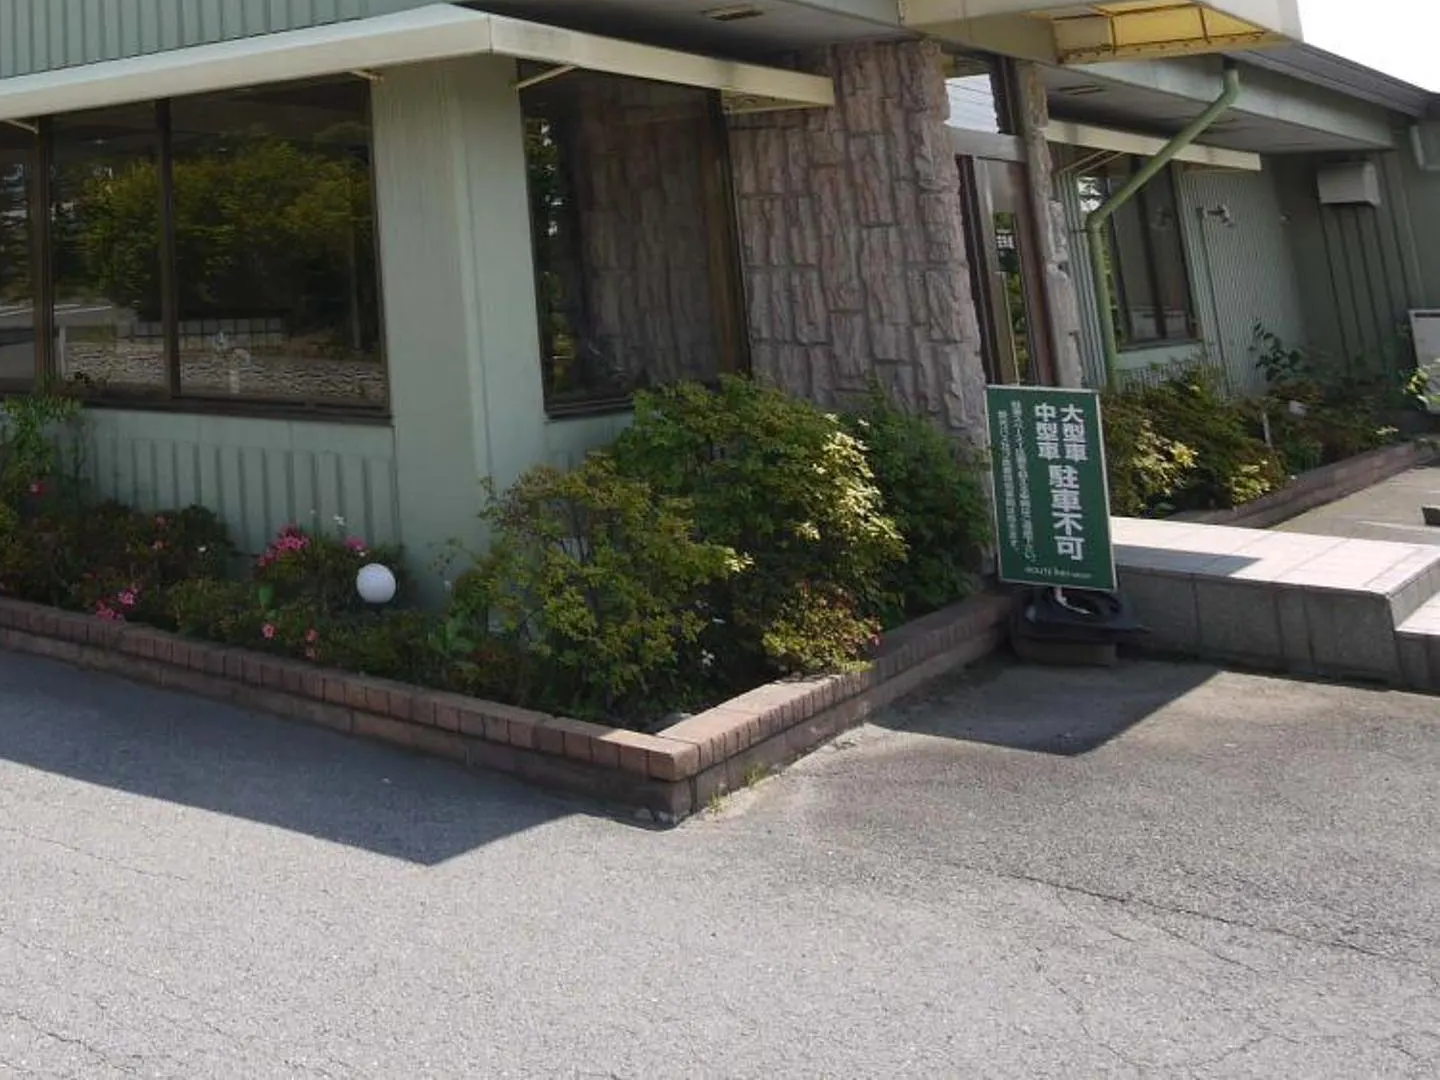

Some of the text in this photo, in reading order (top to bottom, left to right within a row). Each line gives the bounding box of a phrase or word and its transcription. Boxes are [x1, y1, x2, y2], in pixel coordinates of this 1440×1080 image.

[1034, 402, 1061, 460] 中型車
[1060, 404, 1088, 462] 大型車
[1048, 464, 1085, 561] 駐車不可
